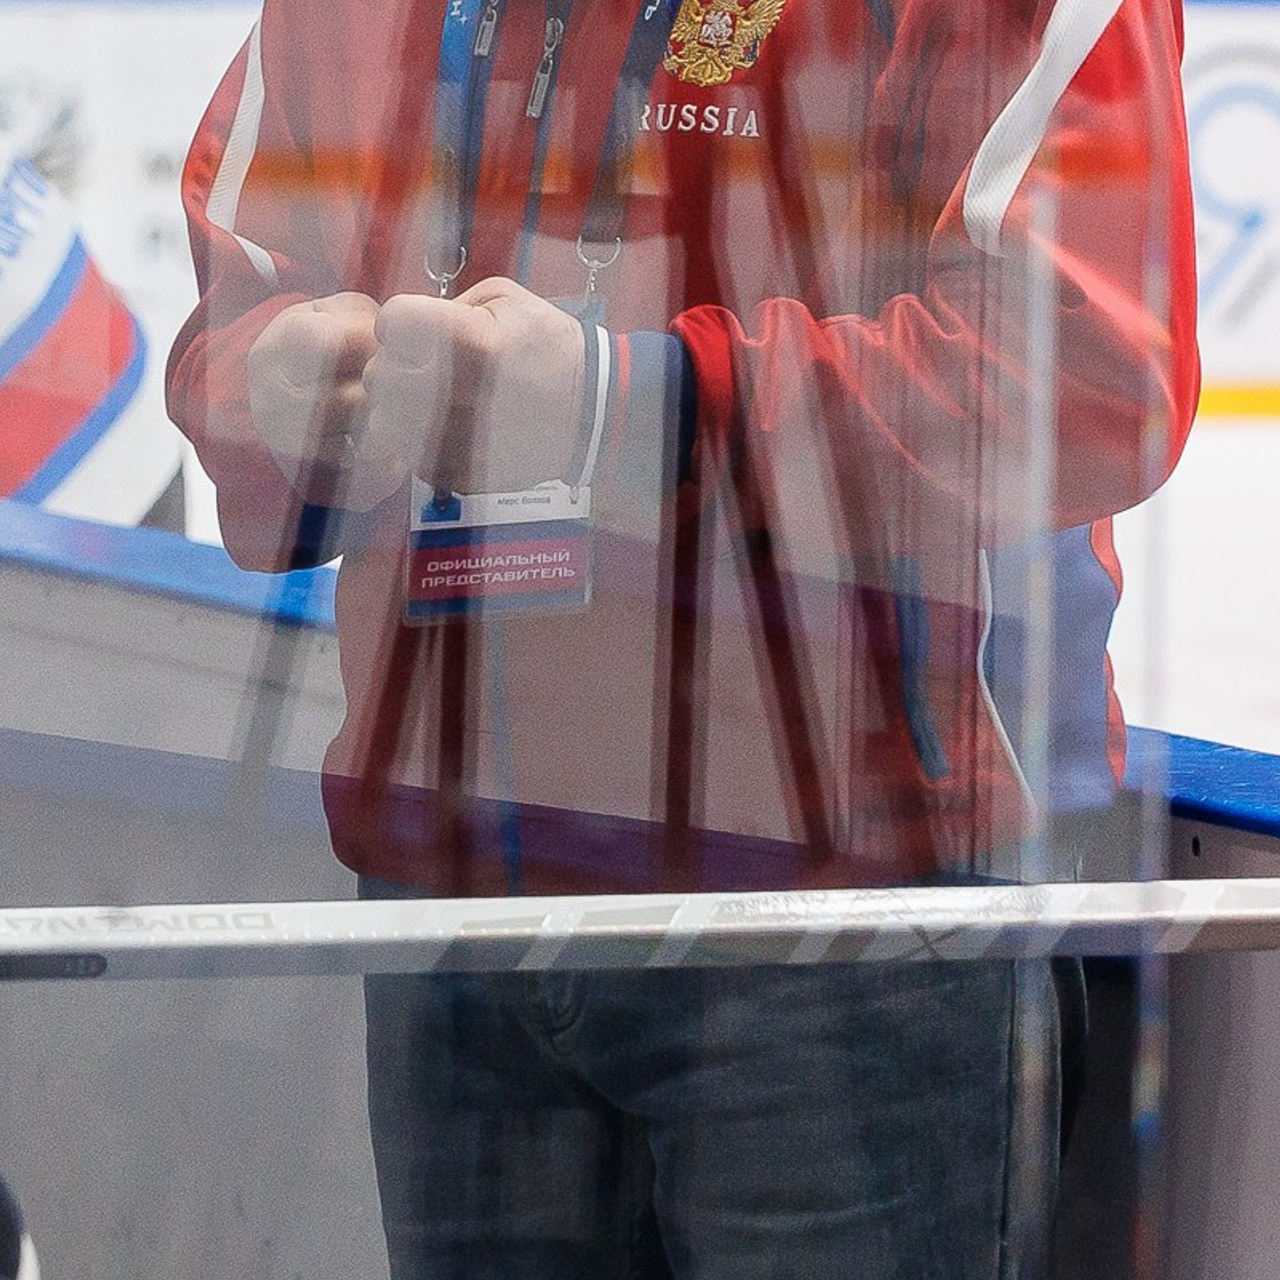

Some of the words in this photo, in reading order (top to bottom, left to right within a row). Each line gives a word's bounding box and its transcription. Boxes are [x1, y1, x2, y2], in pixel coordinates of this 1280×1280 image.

[637, 103, 761, 138] RUSSIA
[426, 549, 570, 572] ОФИЦИАЛЬНЫЙ
[421, 567, 576, 588] ПРЕДСТАВИТЕЛЬ
